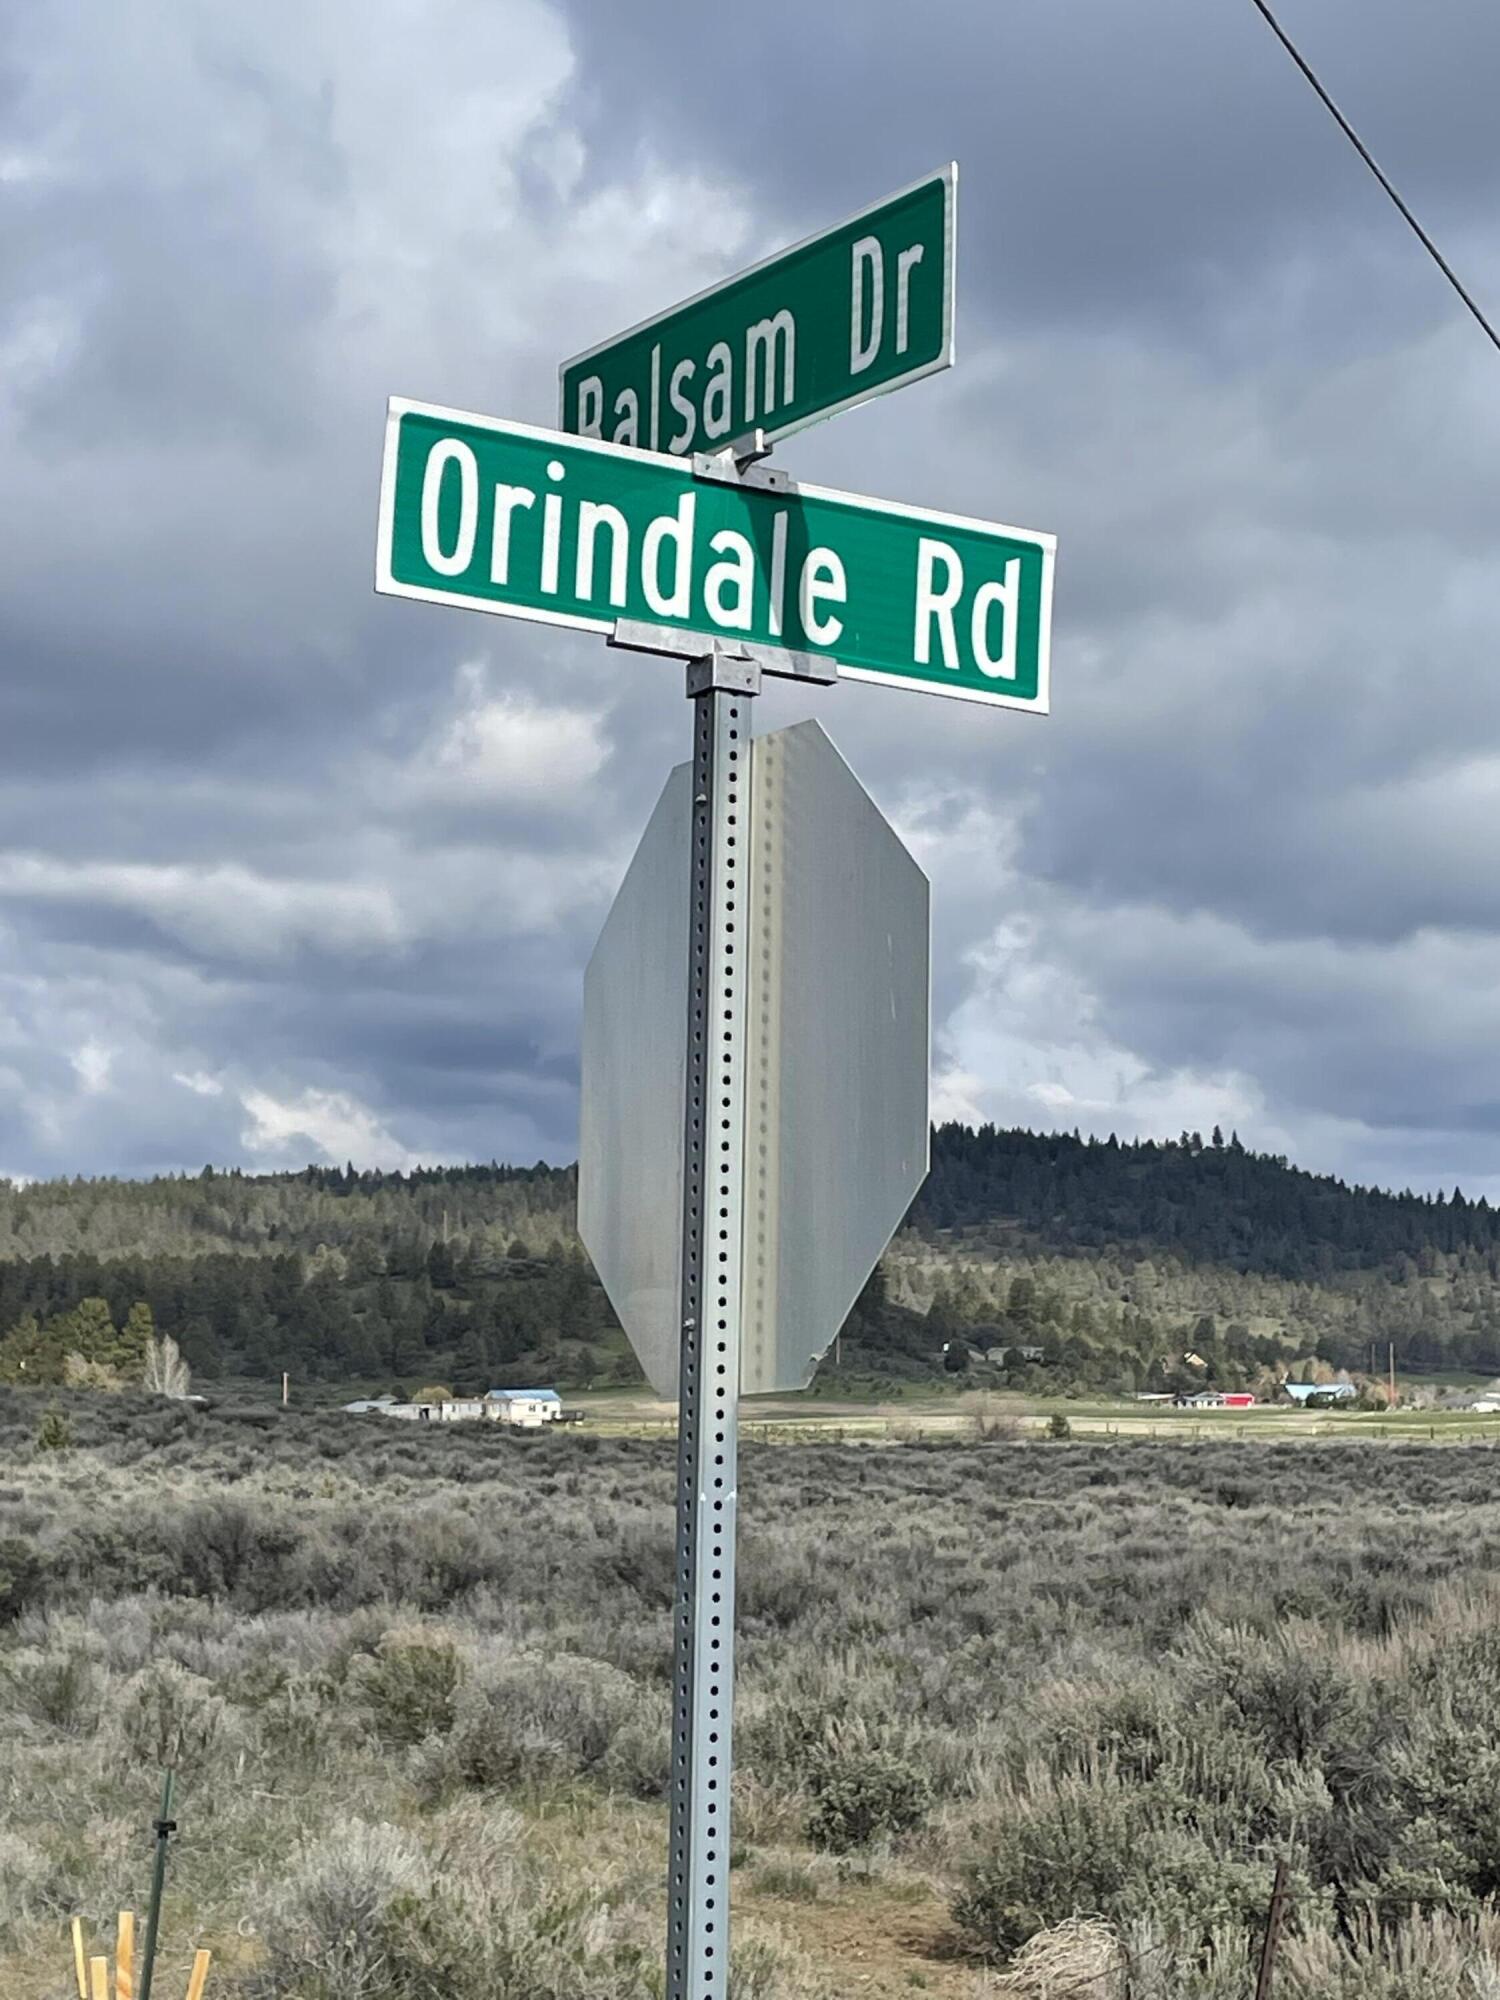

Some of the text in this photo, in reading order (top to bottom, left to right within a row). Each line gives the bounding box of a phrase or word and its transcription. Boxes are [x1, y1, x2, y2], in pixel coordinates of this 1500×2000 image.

[578, 235, 924, 455] Balsam Dr
[420, 438, 1020, 680] Orindale Rd
